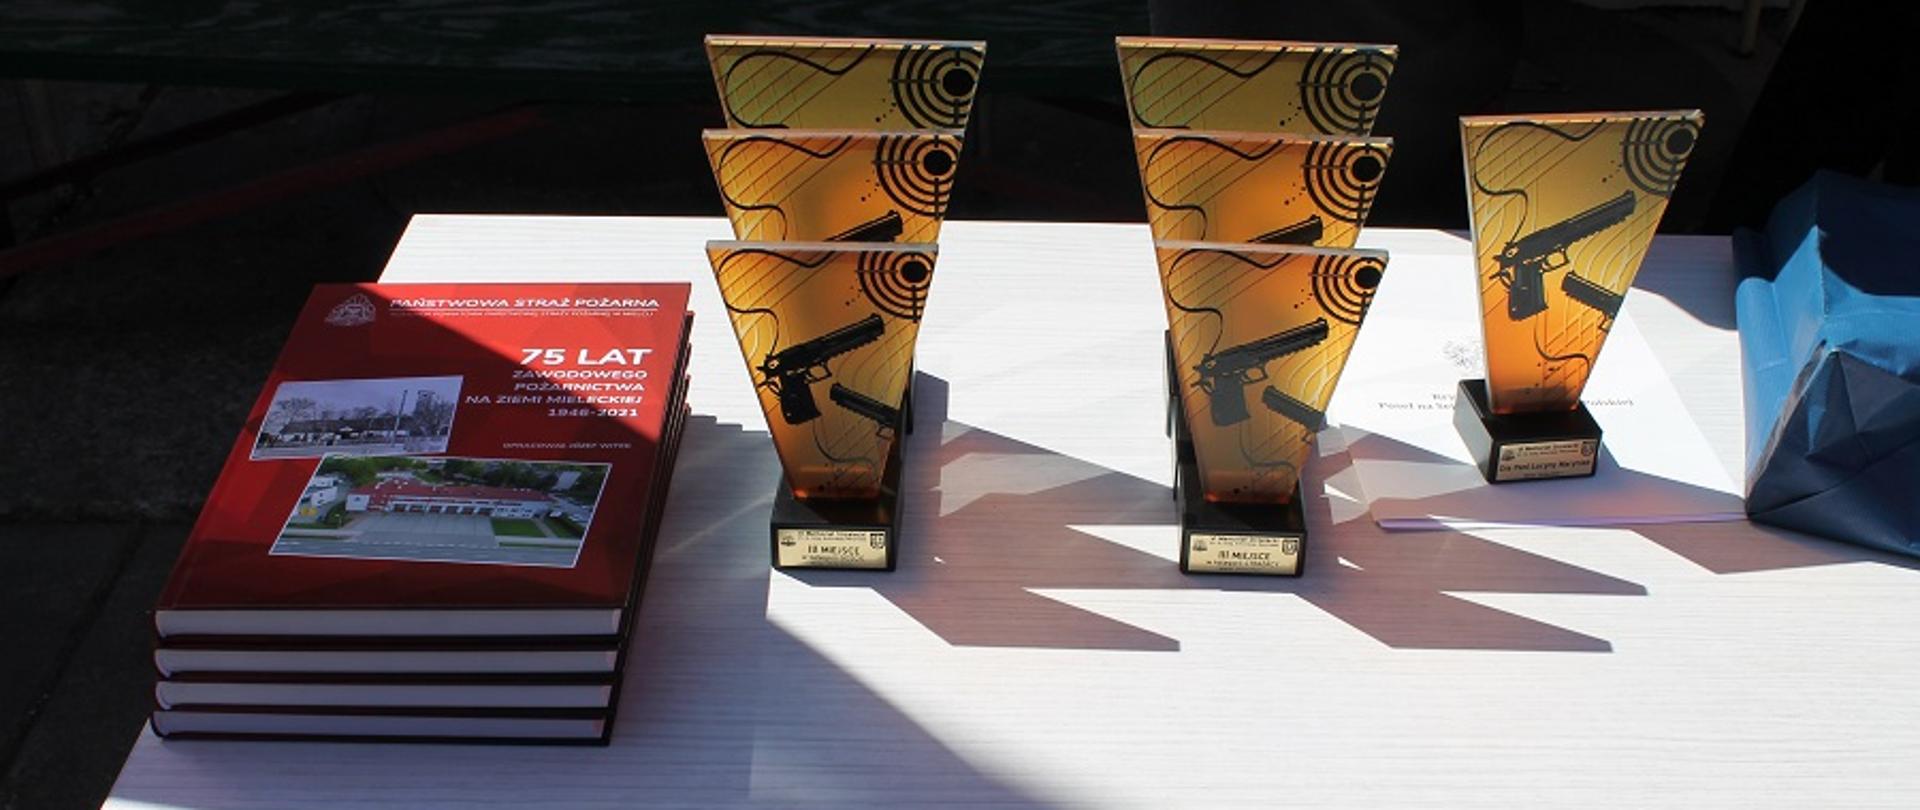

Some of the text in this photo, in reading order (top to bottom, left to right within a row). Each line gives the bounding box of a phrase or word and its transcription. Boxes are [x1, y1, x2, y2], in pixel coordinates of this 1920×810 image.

[390, 298, 660, 307] PAŃSTWOWA STRAŻ POŻARNA
[520, 349, 653, 365] 75 LAT
[512, 370, 648, 379] ZAWODOWEGO
[514, 382, 645, 391] POŻARNICTWA
[465, 395, 643, 404] NA ZIEMI MIELECKIEJ
[821, 546, 861, 556] MIEJSCE
[1232, 552, 1271, 561] MIEJSCE
